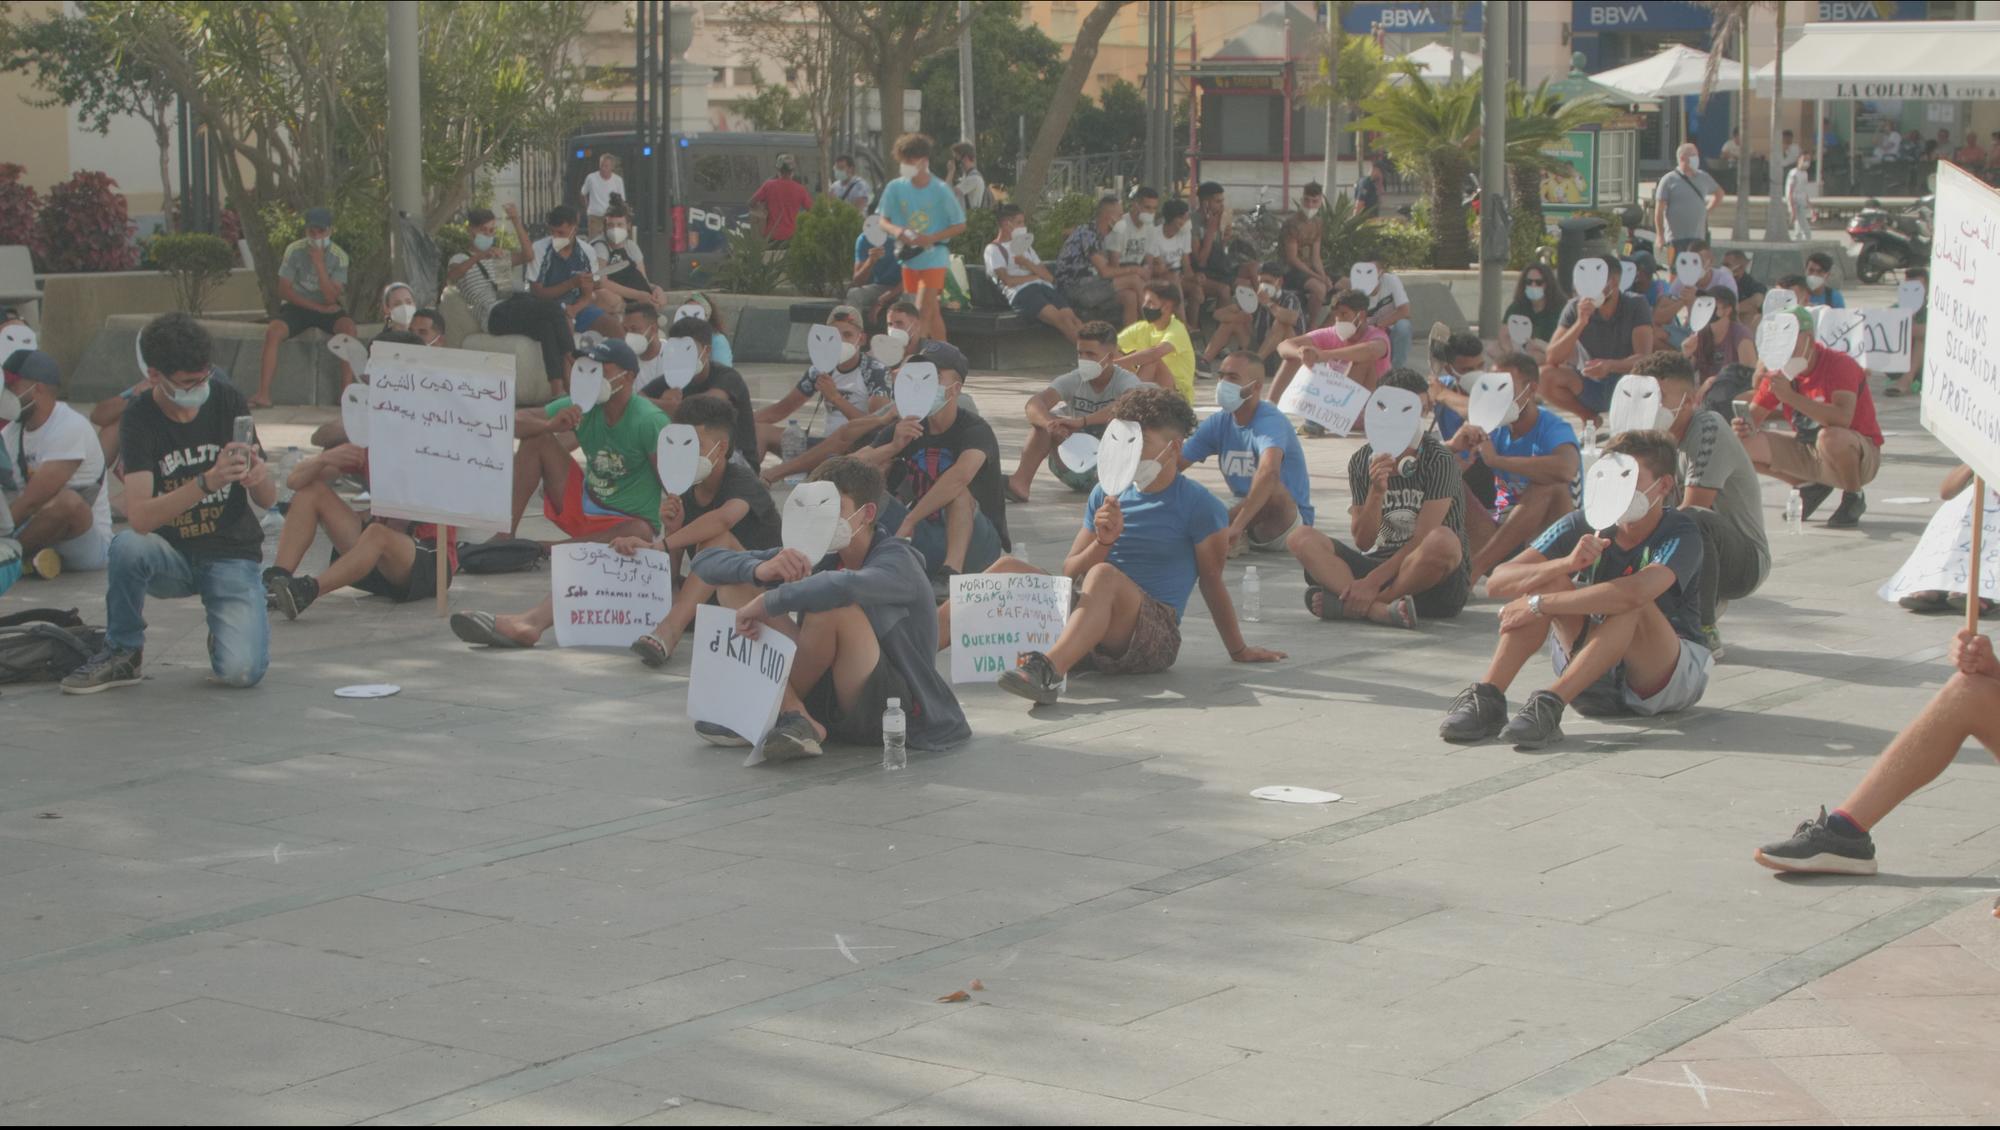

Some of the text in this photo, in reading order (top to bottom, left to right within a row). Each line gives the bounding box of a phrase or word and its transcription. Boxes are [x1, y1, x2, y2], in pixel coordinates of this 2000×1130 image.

[1382, 8, 1434, 27] BBVA
[1591, 5, 1648, 25] BBVA
[1818, 2, 1878, 20] BBVA
[1837, 83, 1858, 97] LA
[1865, 82, 1949, 97] COLUMNA
[1934, 284, 1987, 347] QUEREMOS
[1946, 329, 2000, 396] SEGURIDA
[1928, 358, 1938, 395] Y
[570, 608, 632, 625] DERECHOS
[961, 632, 1020, 648] QUEREMOS
[973, 655, 1006, 673] VIDA
